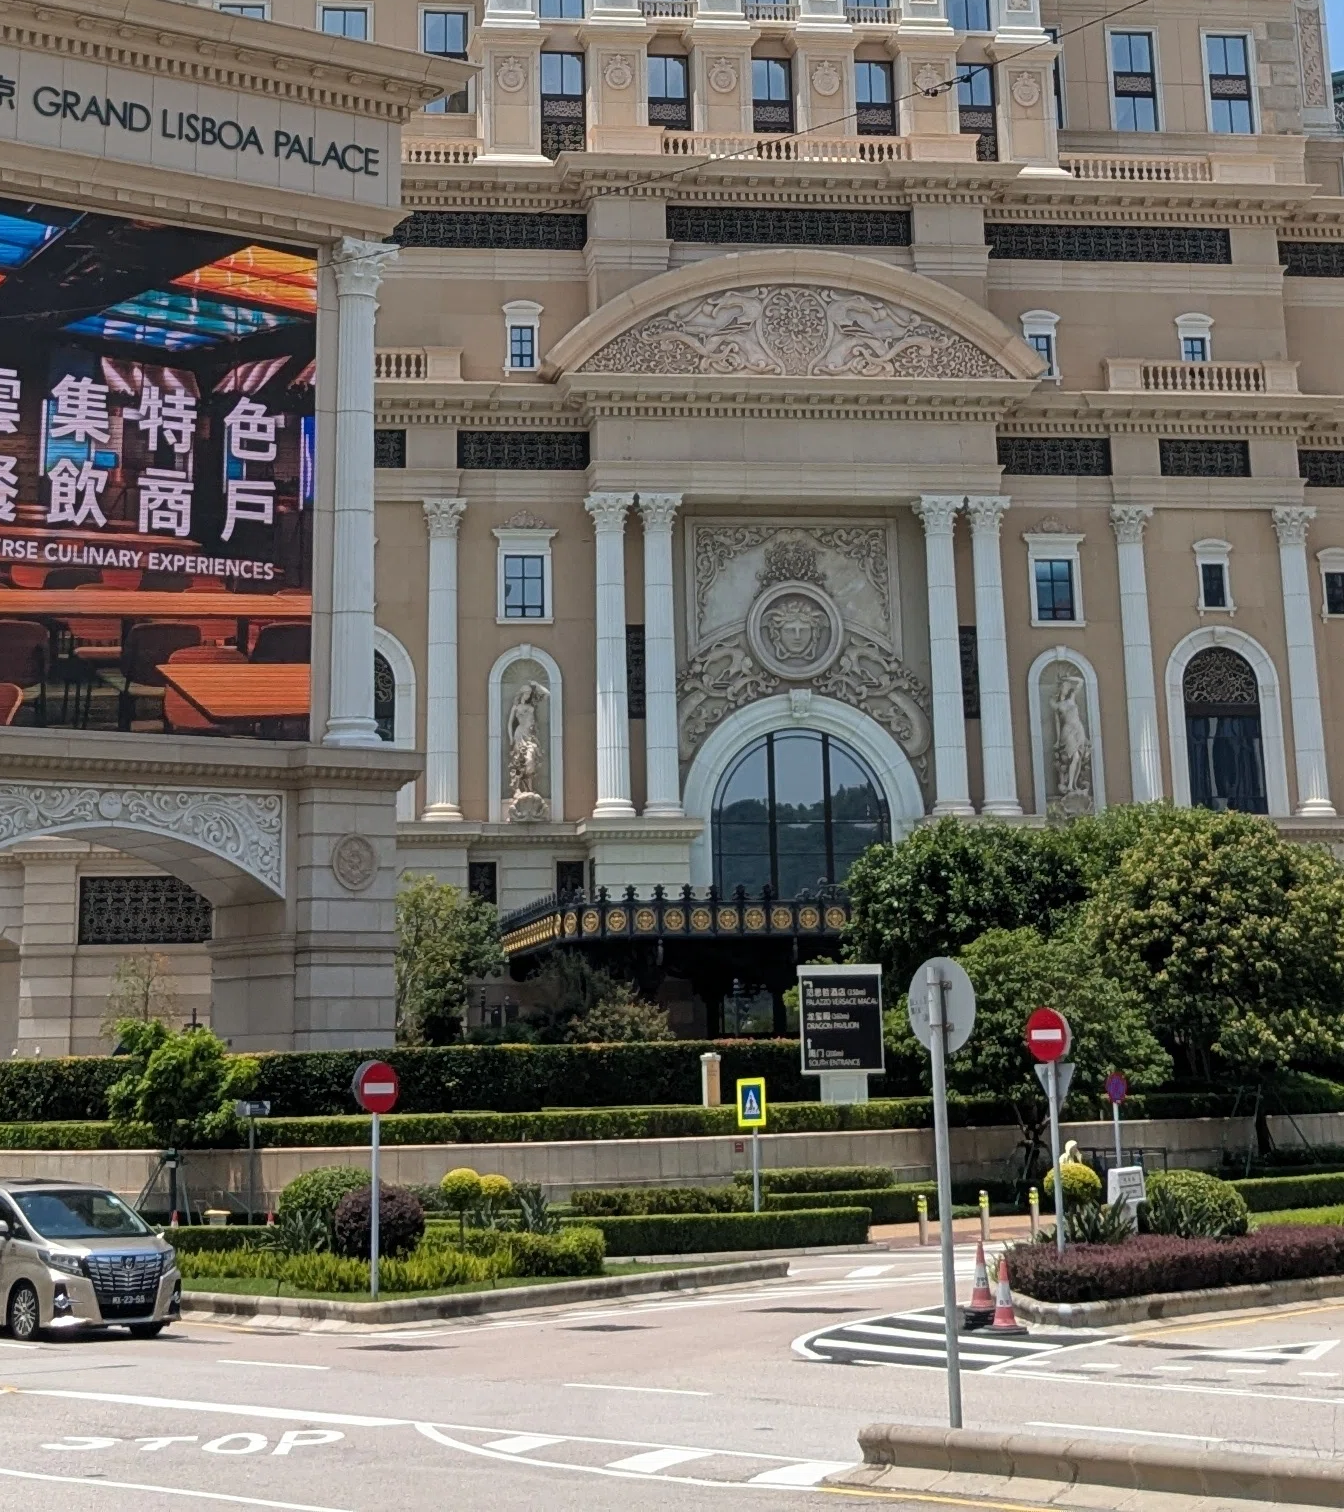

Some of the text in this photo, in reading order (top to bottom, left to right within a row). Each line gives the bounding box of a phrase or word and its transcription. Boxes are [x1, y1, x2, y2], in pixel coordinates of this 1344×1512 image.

[33, 85, 152, 133] GRAND
[162, 108, 264, 155] LISBOA
[274, 130, 379, 176] PALACE
[44, 542, 143, 569] CULINARY
[147, 552, 274, 580] EXPERIENCES
[41, 1430, 345, 1456] STOP
